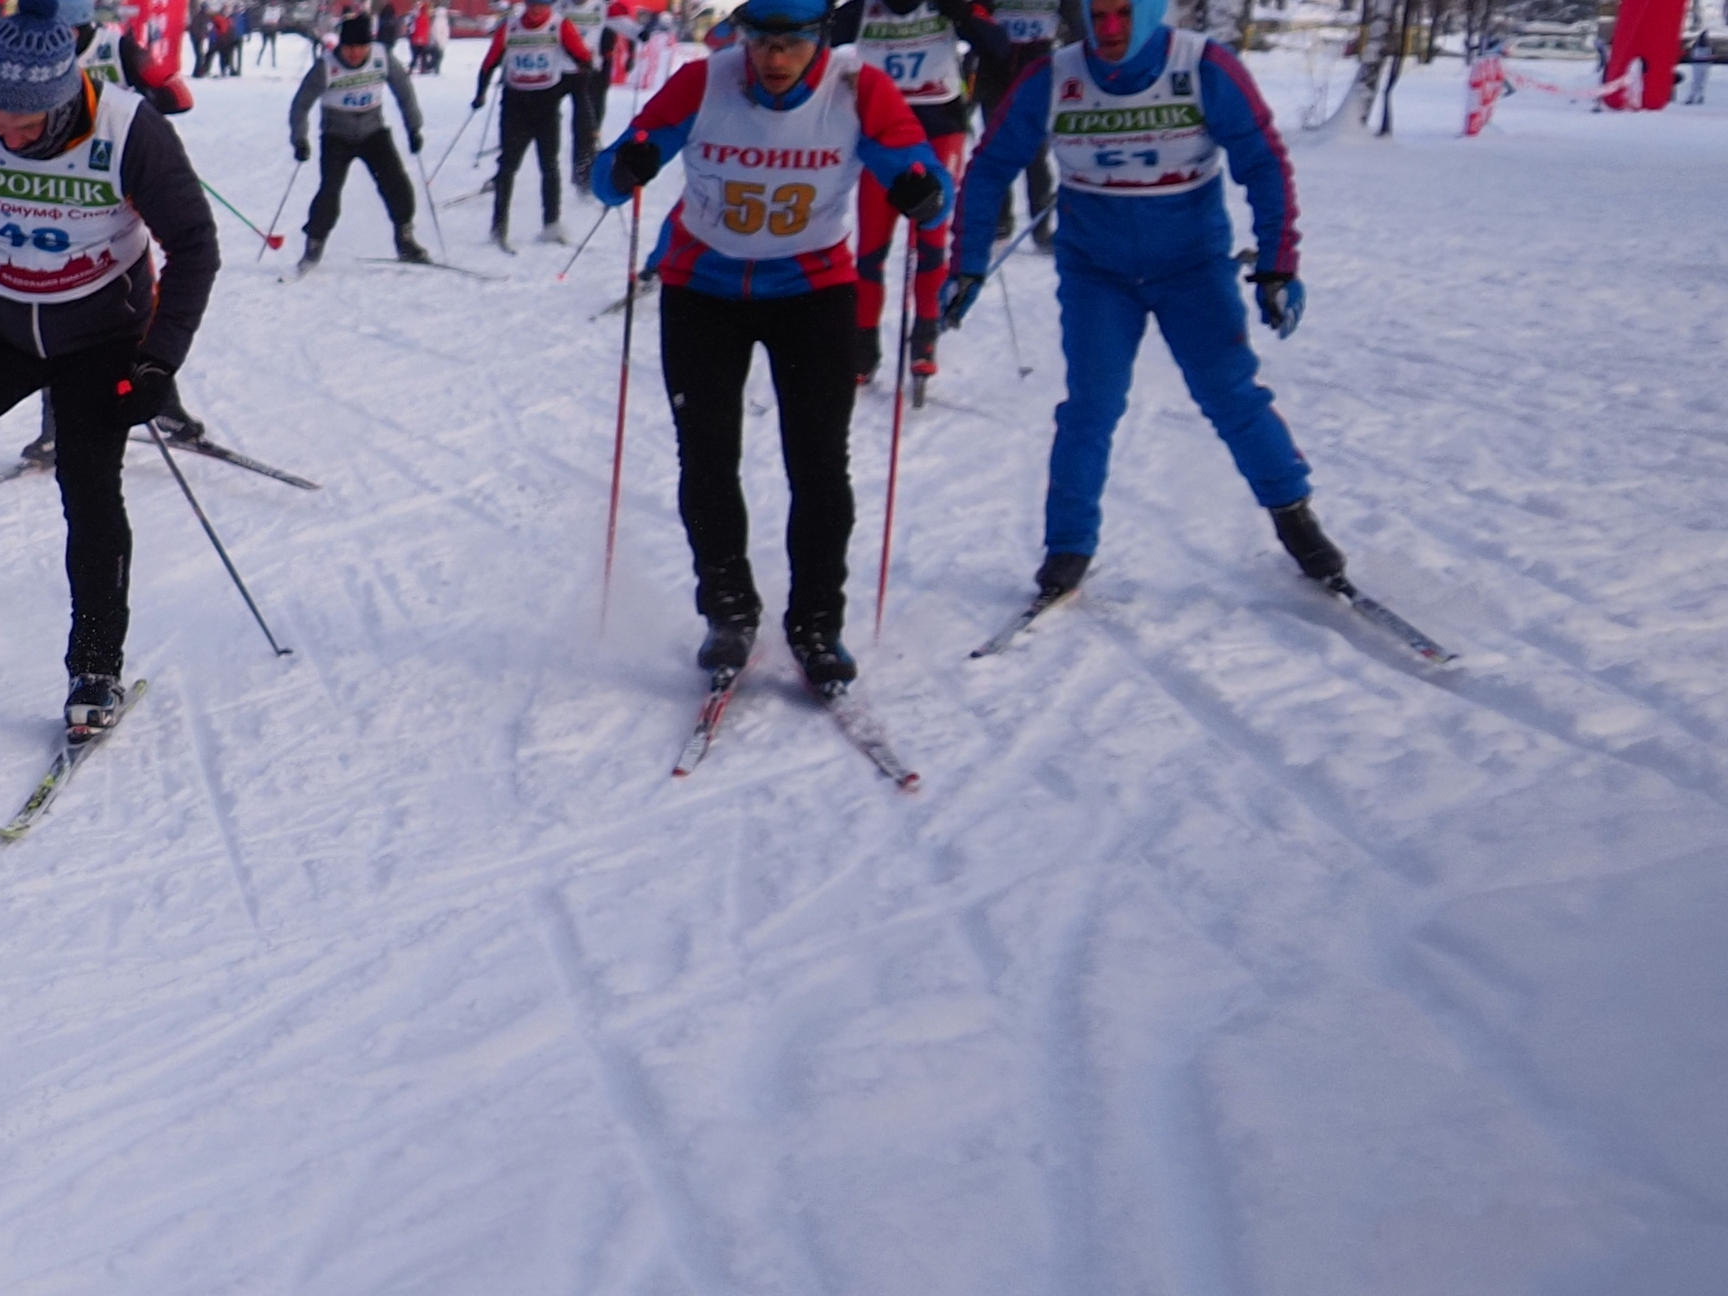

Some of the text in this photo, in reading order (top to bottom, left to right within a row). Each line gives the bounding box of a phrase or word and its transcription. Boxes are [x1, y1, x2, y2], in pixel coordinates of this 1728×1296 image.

[885, 51, 928, 80] 67
[700, 142, 842, 171] ТРОИЦК
[723, 179, 817, 237] 53
